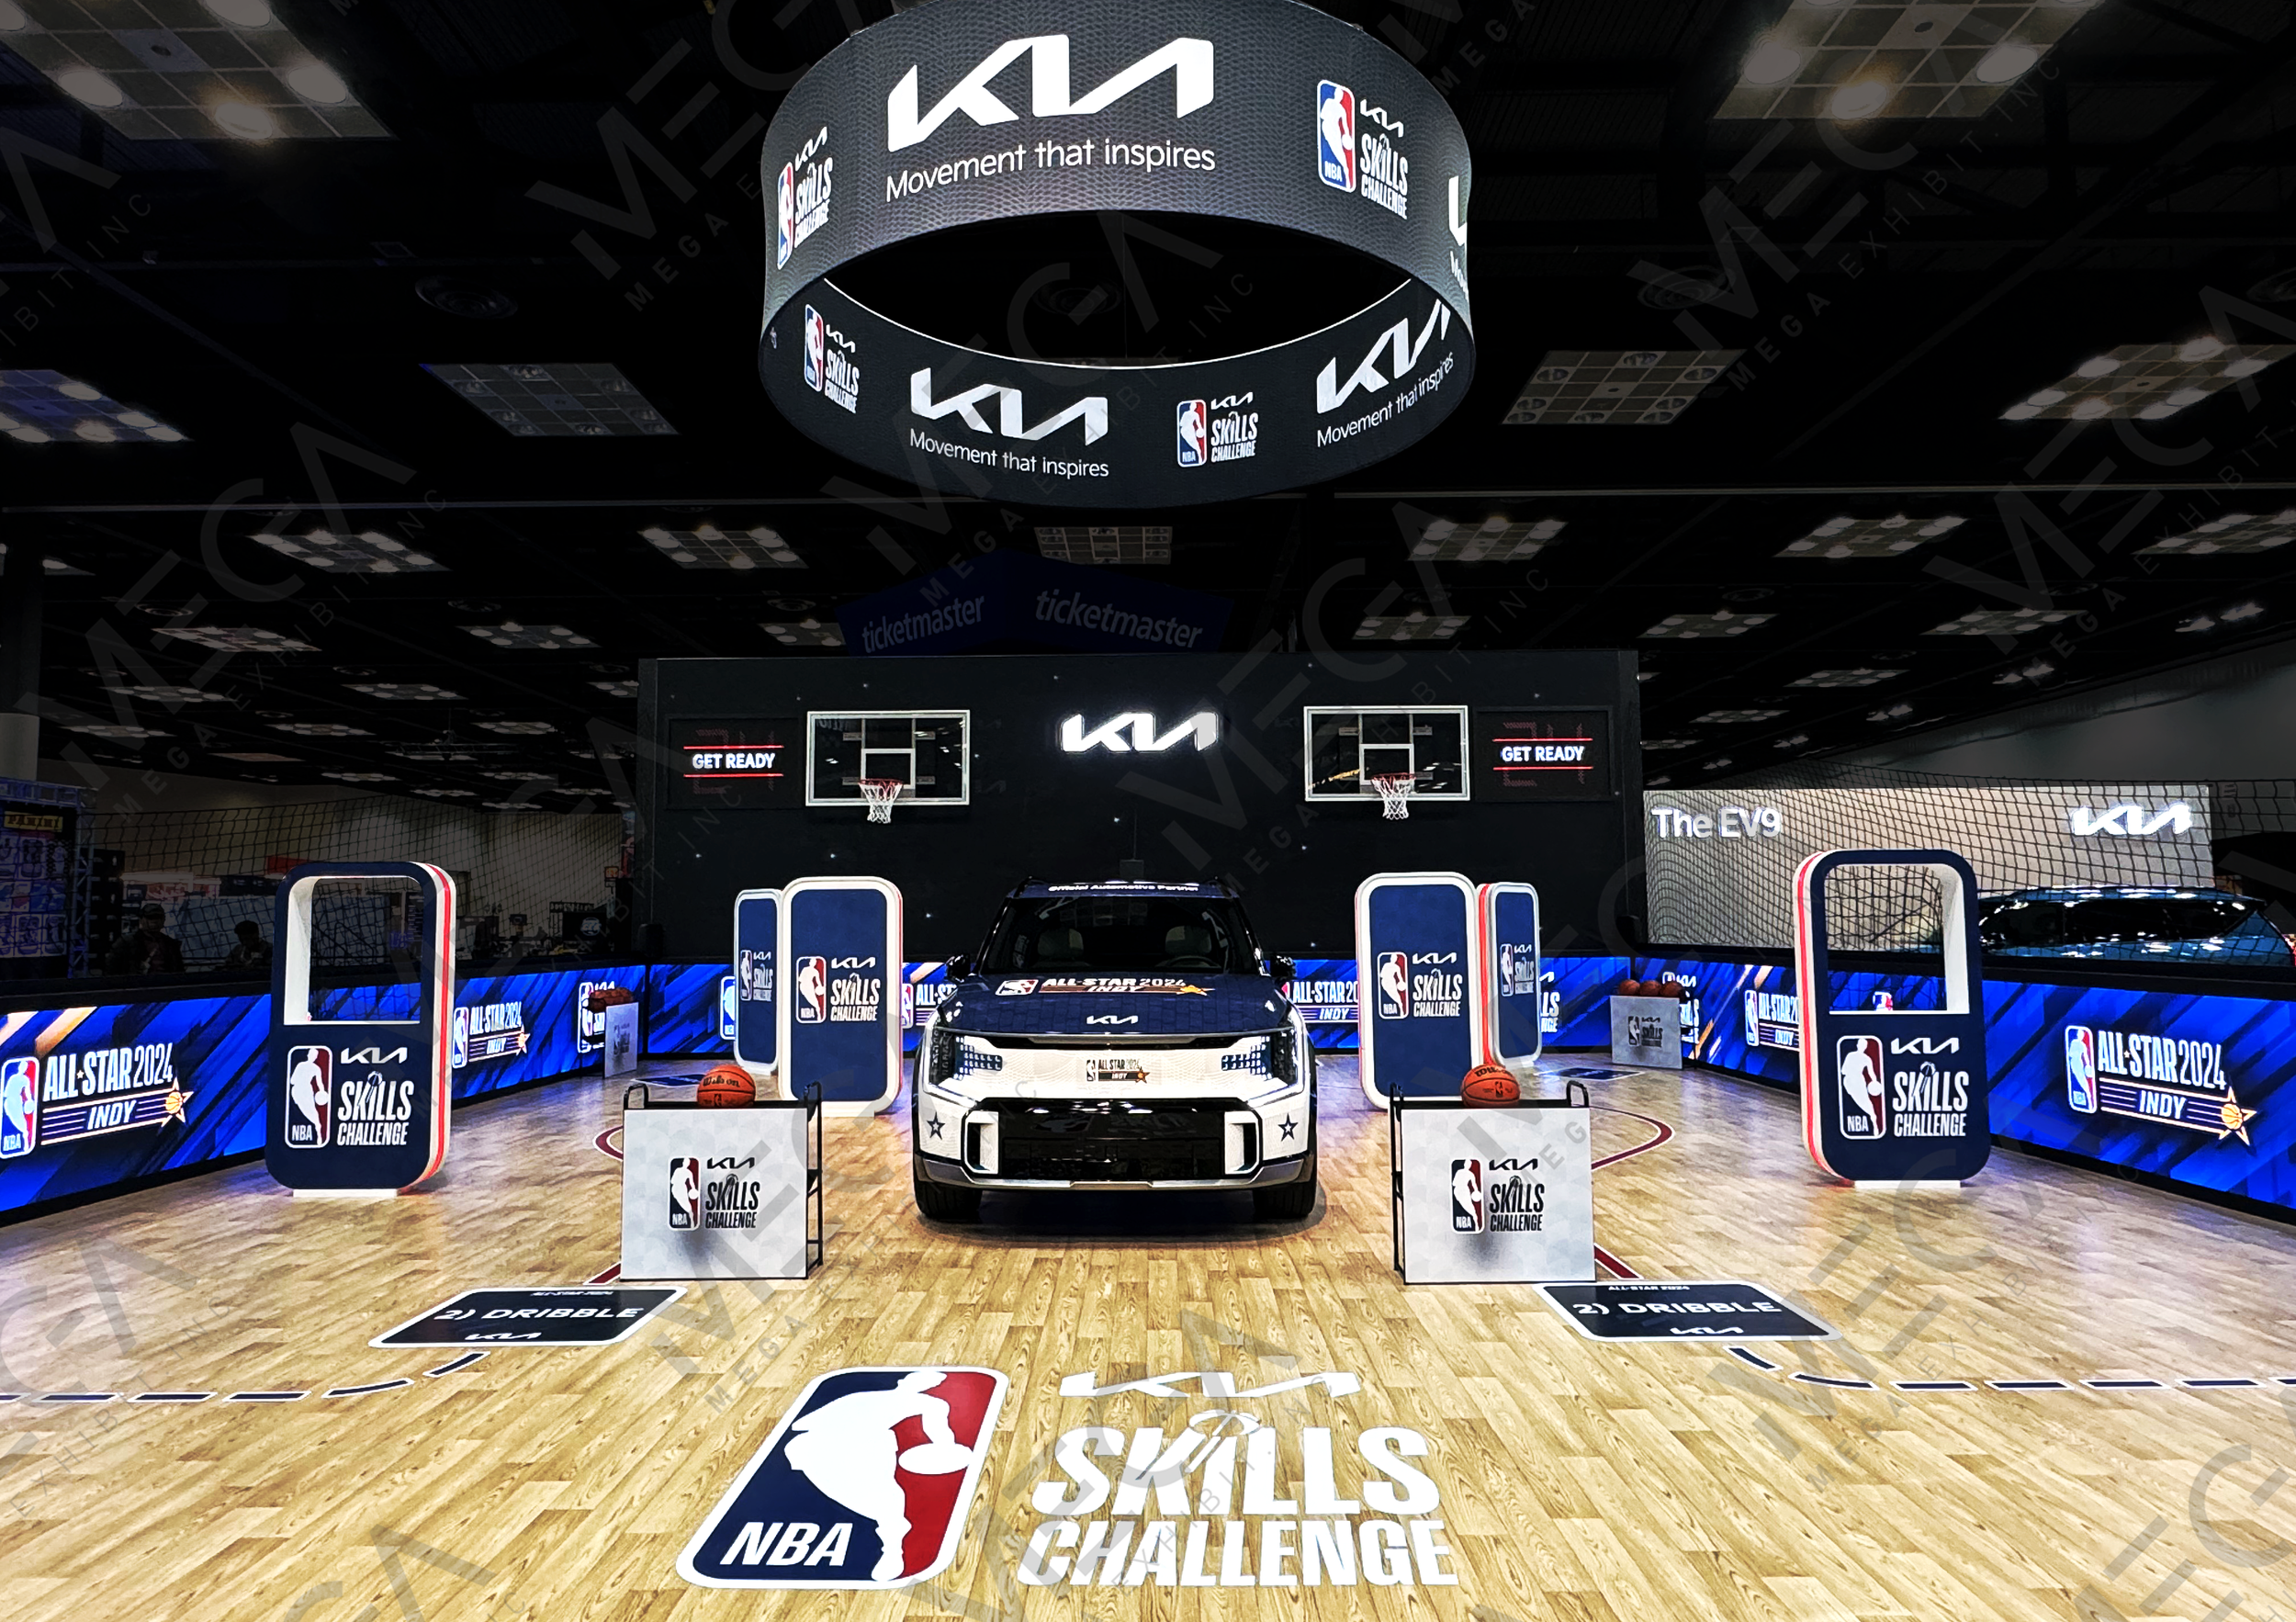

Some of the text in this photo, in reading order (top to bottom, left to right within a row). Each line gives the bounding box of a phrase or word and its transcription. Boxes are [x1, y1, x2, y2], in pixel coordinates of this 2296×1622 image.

[887, 32, 1214, 152] KIA
[1360, 98, 1404, 138] KIA
[886, 138, 1216, 202] Movement that inspires
[1324, 160, 1343, 182] NBA
[1359, 133, 1409, 196] SKILLS
[795, 157, 833, 224] SKILLS
[1361, 173, 1408, 220] CHALLENGE
[1317, 298, 1451, 413] KIA
[826, 349, 860, 397] SKILLS
[910, 367, 1109, 446] KIA
[1210, 391, 1254, 410] KIA
[1317, 352, 1454, 448] Movement that inspires
[1210, 411, 1258, 447] SKILLS
[909, 428, 1109, 479] Movement that inspires
[1211, 440, 1256, 464] CHALLENGE
[861, 595, 985, 654] ticketmaster
[1034, 589, 1203, 648] ticketmaster
[1061, 712, 1219, 752] KIA
[692, 753, 775, 770] GET READY
[1501, 745, 1585, 761] GET READY
[1651, 807, 1782, 839] The EV9
[2070, 803, 2193, 836] KIA
[752, 951, 771, 961] KIA
[831, 957, 875, 969] KIA
[1412, 952, 1457, 963] KIA
[830, 978, 881, 1006] SKILLS
[1140, 978, 1187, 986] 2024
[1412, 974, 1463, 1002] SKILLS
[801, 1008, 815, 1019] NBA
[830, 1006, 878, 1022] CHALLENGE
[1086, 1015, 1139, 1025] KIA
[1320, 1008, 1349, 1020] INDY
[1383, 1004, 1398, 1015] NBA
[1412, 1001, 1461, 1017] CHALLENGE
[341, 1047, 408, 1064] KIA
[1890, 1037, 1959, 1054] KIA
[133, 1042, 174, 1087] 2024
[2178, 1040, 2227, 1090] 2024
[337, 1080, 415, 1121] SKILLS
[1892, 1071, 1969, 1112] SKILLS
[87, 1100, 137, 1131] INDY
[2139, 1090, 2187, 1120] INDY
[291, 1124, 313, 1142] NBA
[336, 1121, 410, 1146] CHALLENGE
[1847, 1116, 1869, 1132] NBA
[1894, 1112, 1967, 1137] CHALLENGE
[706, 1157, 755, 1169] KIA
[1489, 1158, 1538, 1171] KIA
[705, 1181, 760, 1211] SKILLS
[1490, 1183, 1545, 1213] SKILLS
[671, 1212, 688, 1225] NBA
[705, 1211, 757, 1229] CHALLENGE
[1456, 1215, 1472, 1229] NBA
[1490, 1214, 1543, 1232] CHALLENGE
[433, 1307, 644, 1321] 2) DRIBBLE
[1573, 1301, 1783, 1315] 2) DRIBBLE
[465, 1332, 542, 1340] KIA
[1670, 1326, 1744, 1335] KIA
[1059, 1371, 1360, 1397] KIA
[1031, 1425, 1441, 1515] SKILLS
[719, 1522, 853, 1568] NBA
[1017, 1518, 1459, 1587] CHALLENGE
